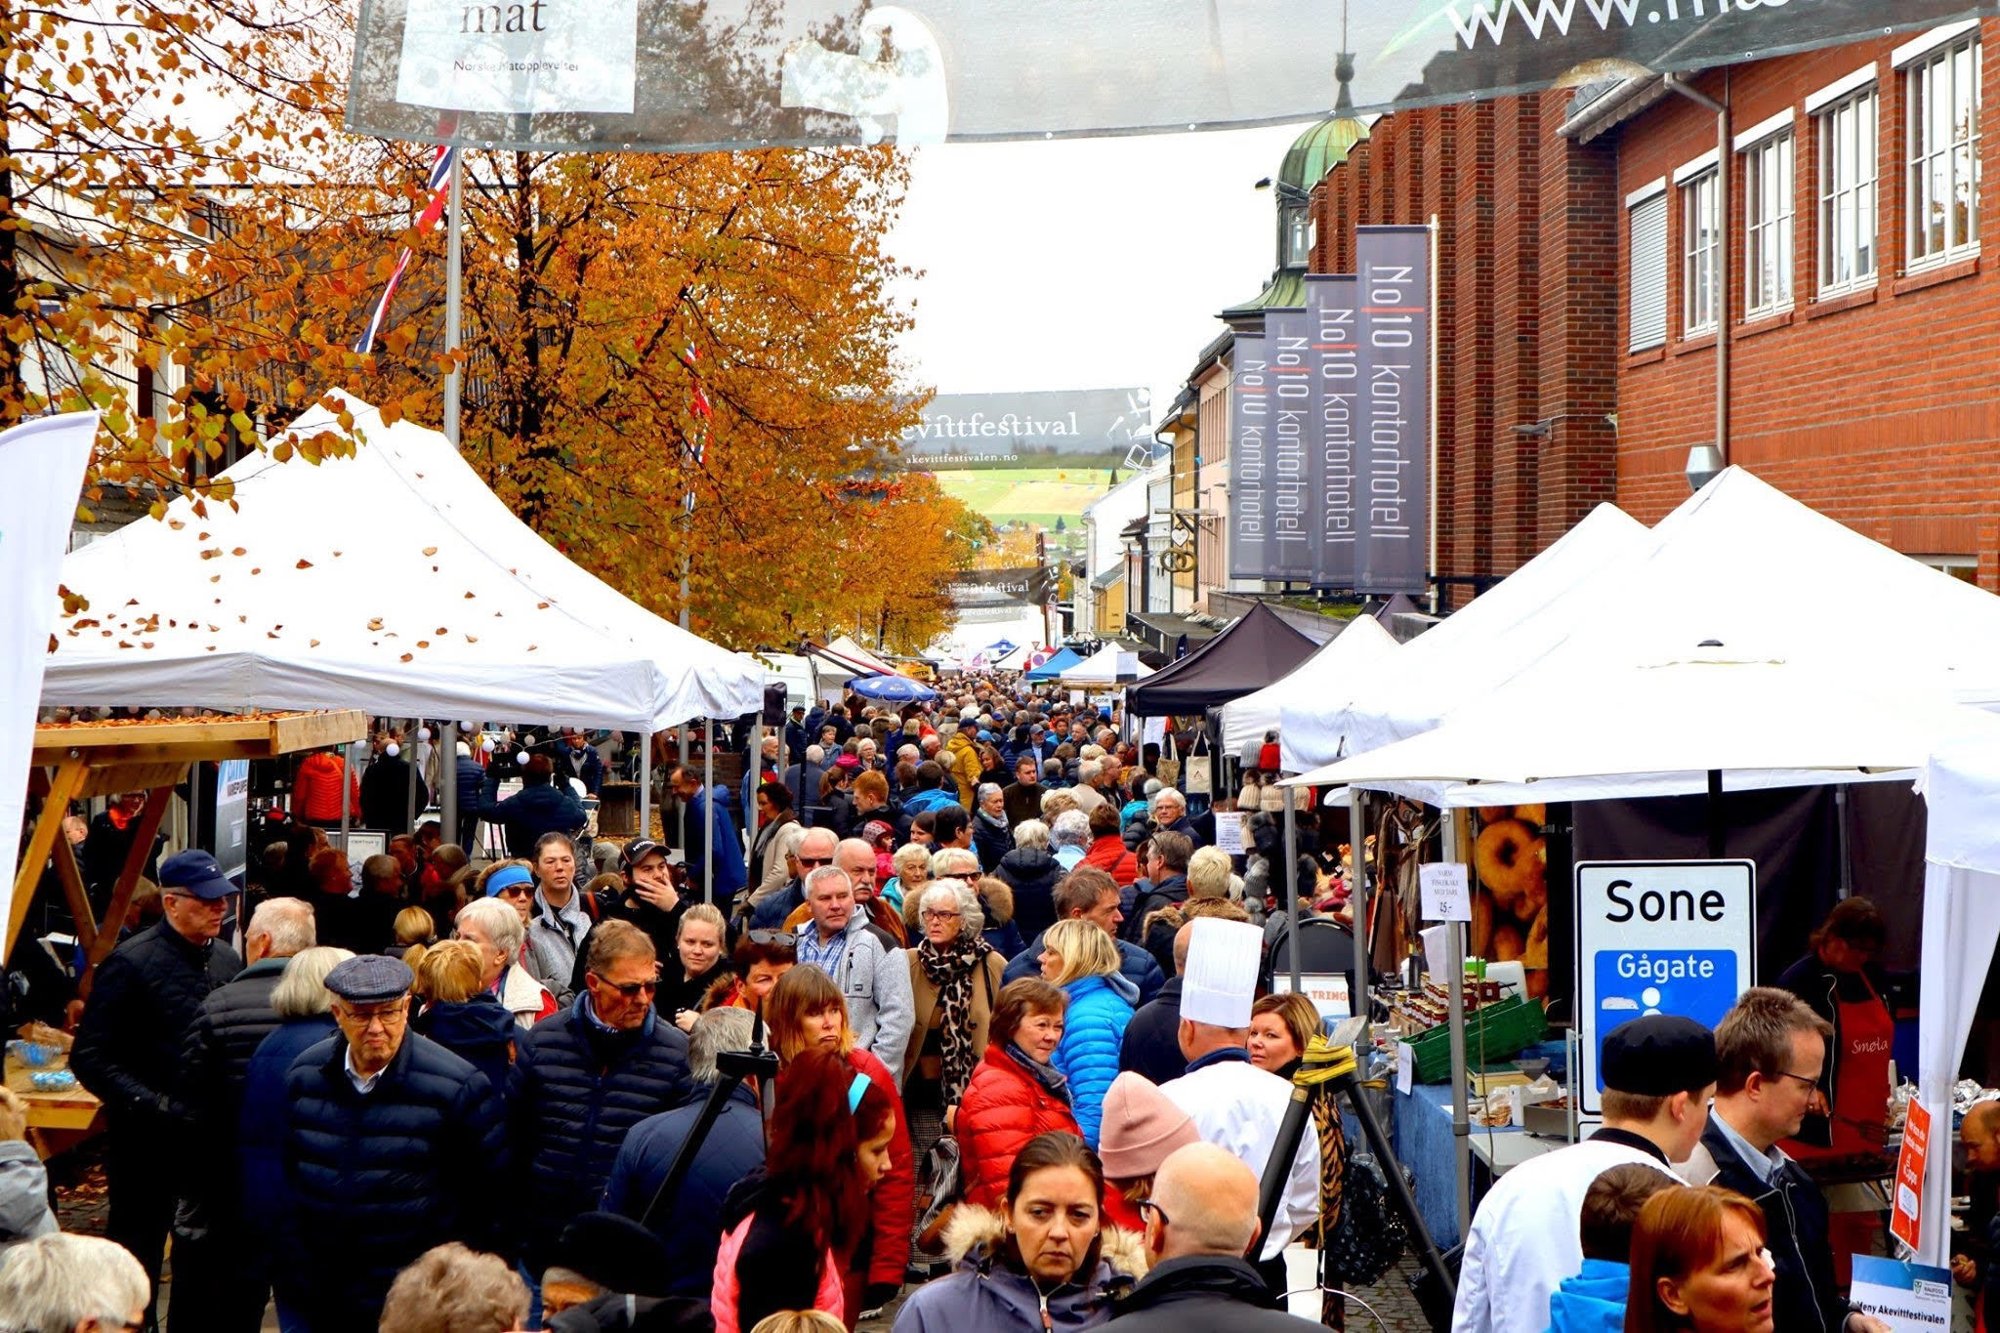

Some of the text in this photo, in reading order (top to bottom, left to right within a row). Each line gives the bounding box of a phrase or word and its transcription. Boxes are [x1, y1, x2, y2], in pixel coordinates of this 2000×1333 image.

[461, 0, 547, 33] mat
[453, 60, 495, 71] Norske
[905, 453, 1018, 464] akevittfestivalen.no
[1323, 393, 1358, 542] kontorhotell
[1370, 364, 1411, 538] kontorhotell
[1239, 425, 1266, 542] kontorhotell
[1275, 410, 1308, 540] kontorhotell
[1605, 879, 1726, 923] Sone
[1617, 953, 1715, 984] Gågate
[1851, 1036, 1889, 1054] Smøla
[1878, 1304, 1945, 1325] Akevittfestivalen
